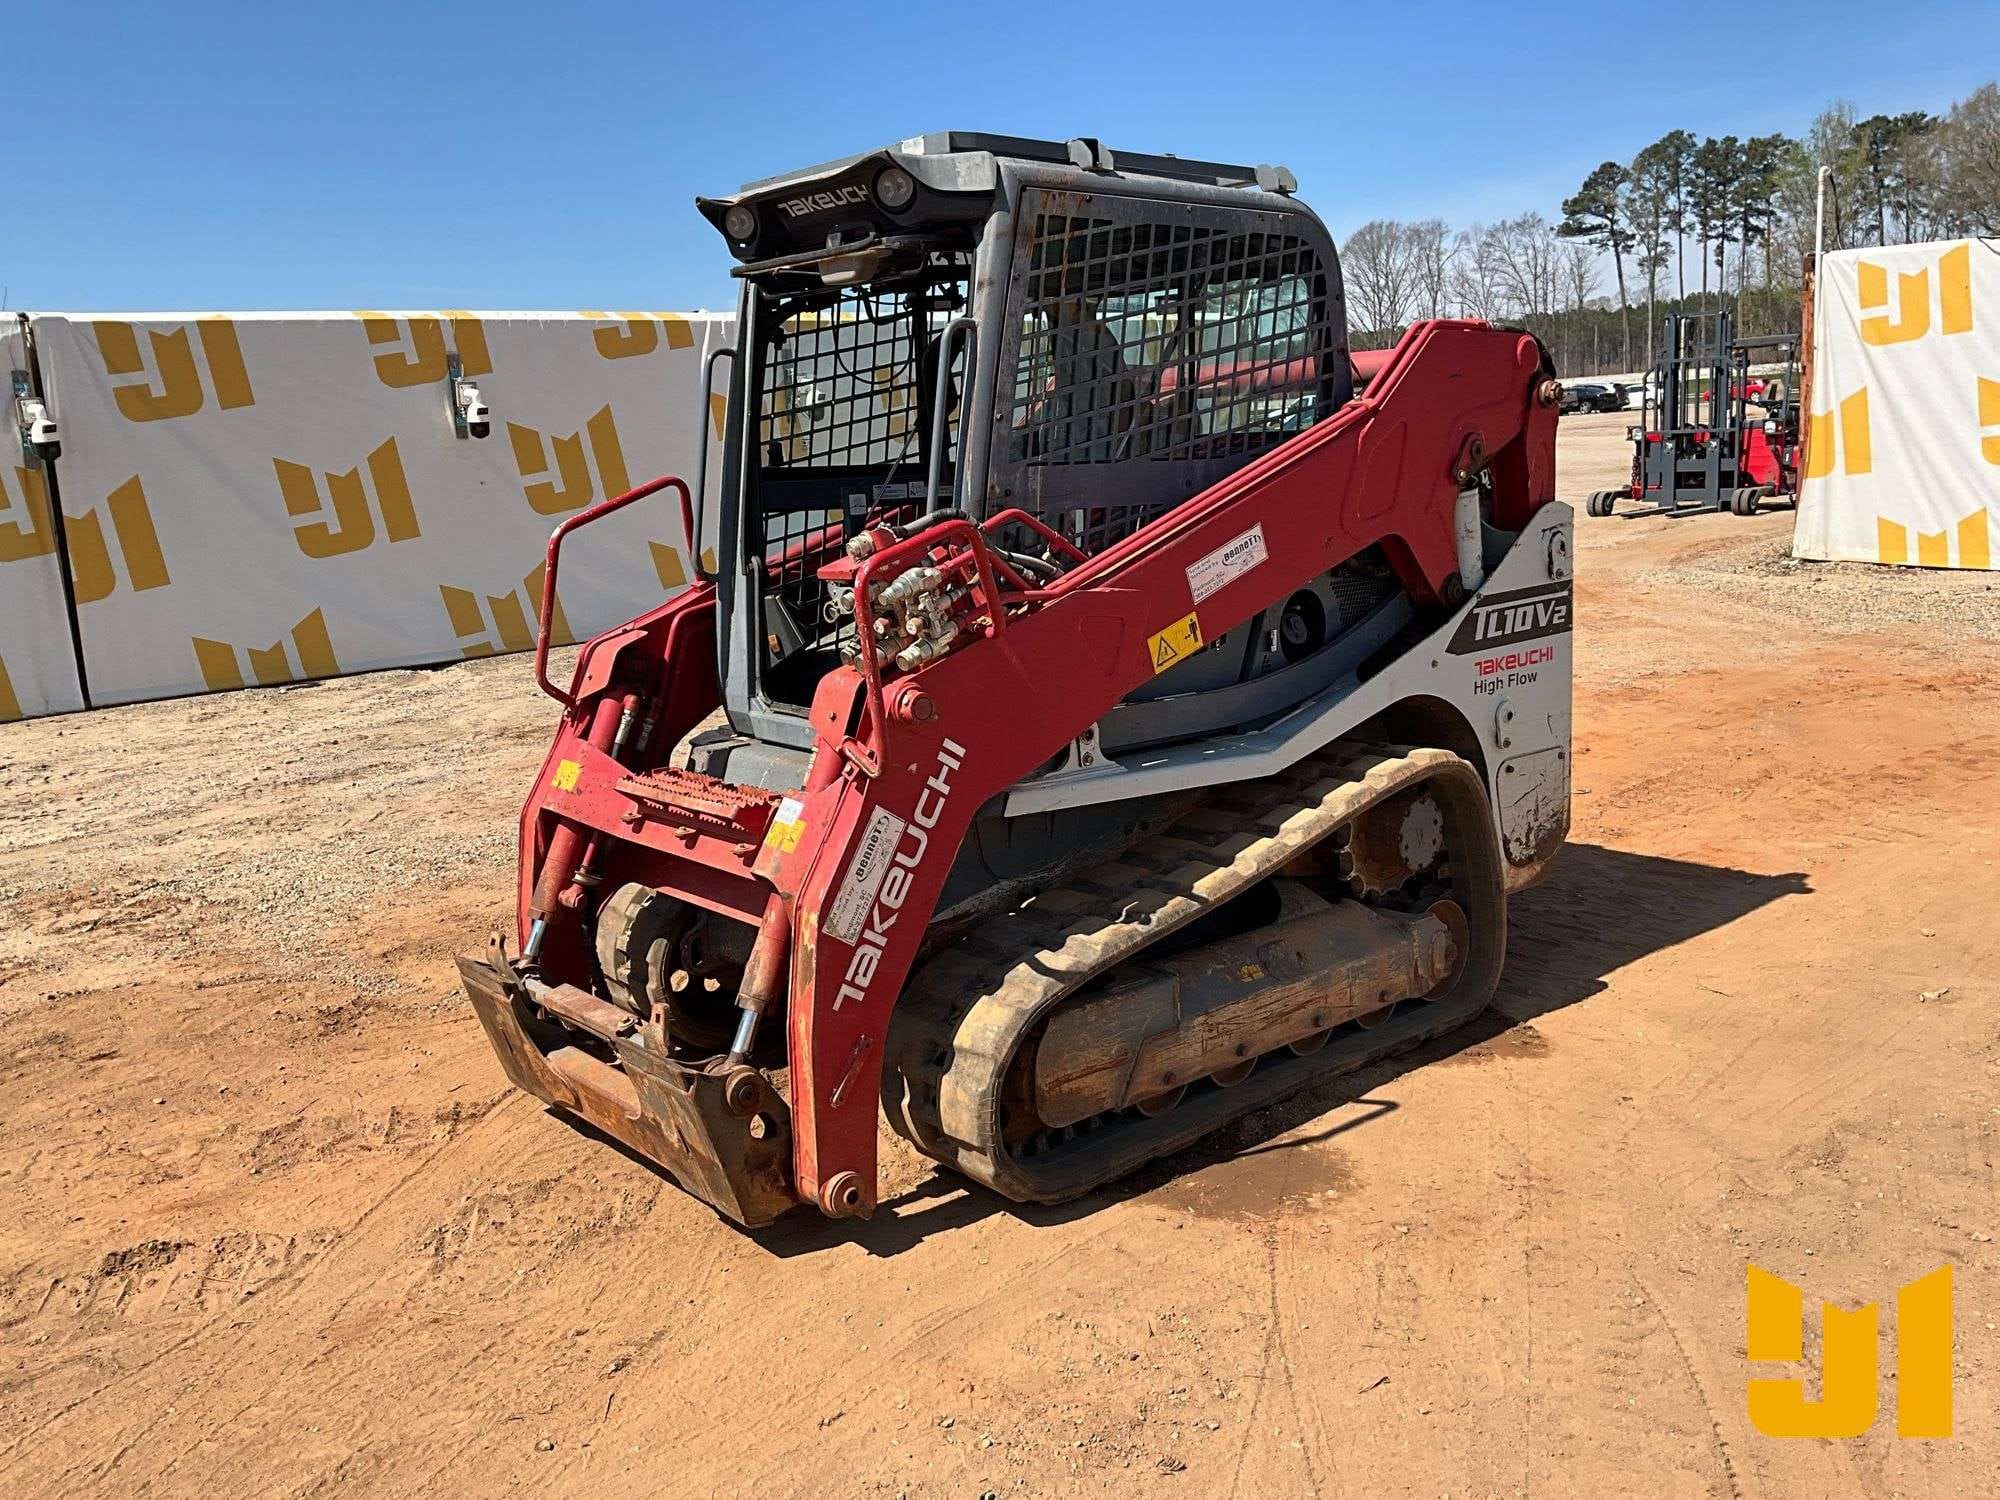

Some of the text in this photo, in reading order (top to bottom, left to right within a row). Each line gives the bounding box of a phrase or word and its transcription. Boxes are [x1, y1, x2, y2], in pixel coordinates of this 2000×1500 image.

[1475, 646, 1555, 677] TAKEUCHI
[1474, 671, 1538, 695] High Flow
[832, 737, 966, 1012] TAKEUCHI
